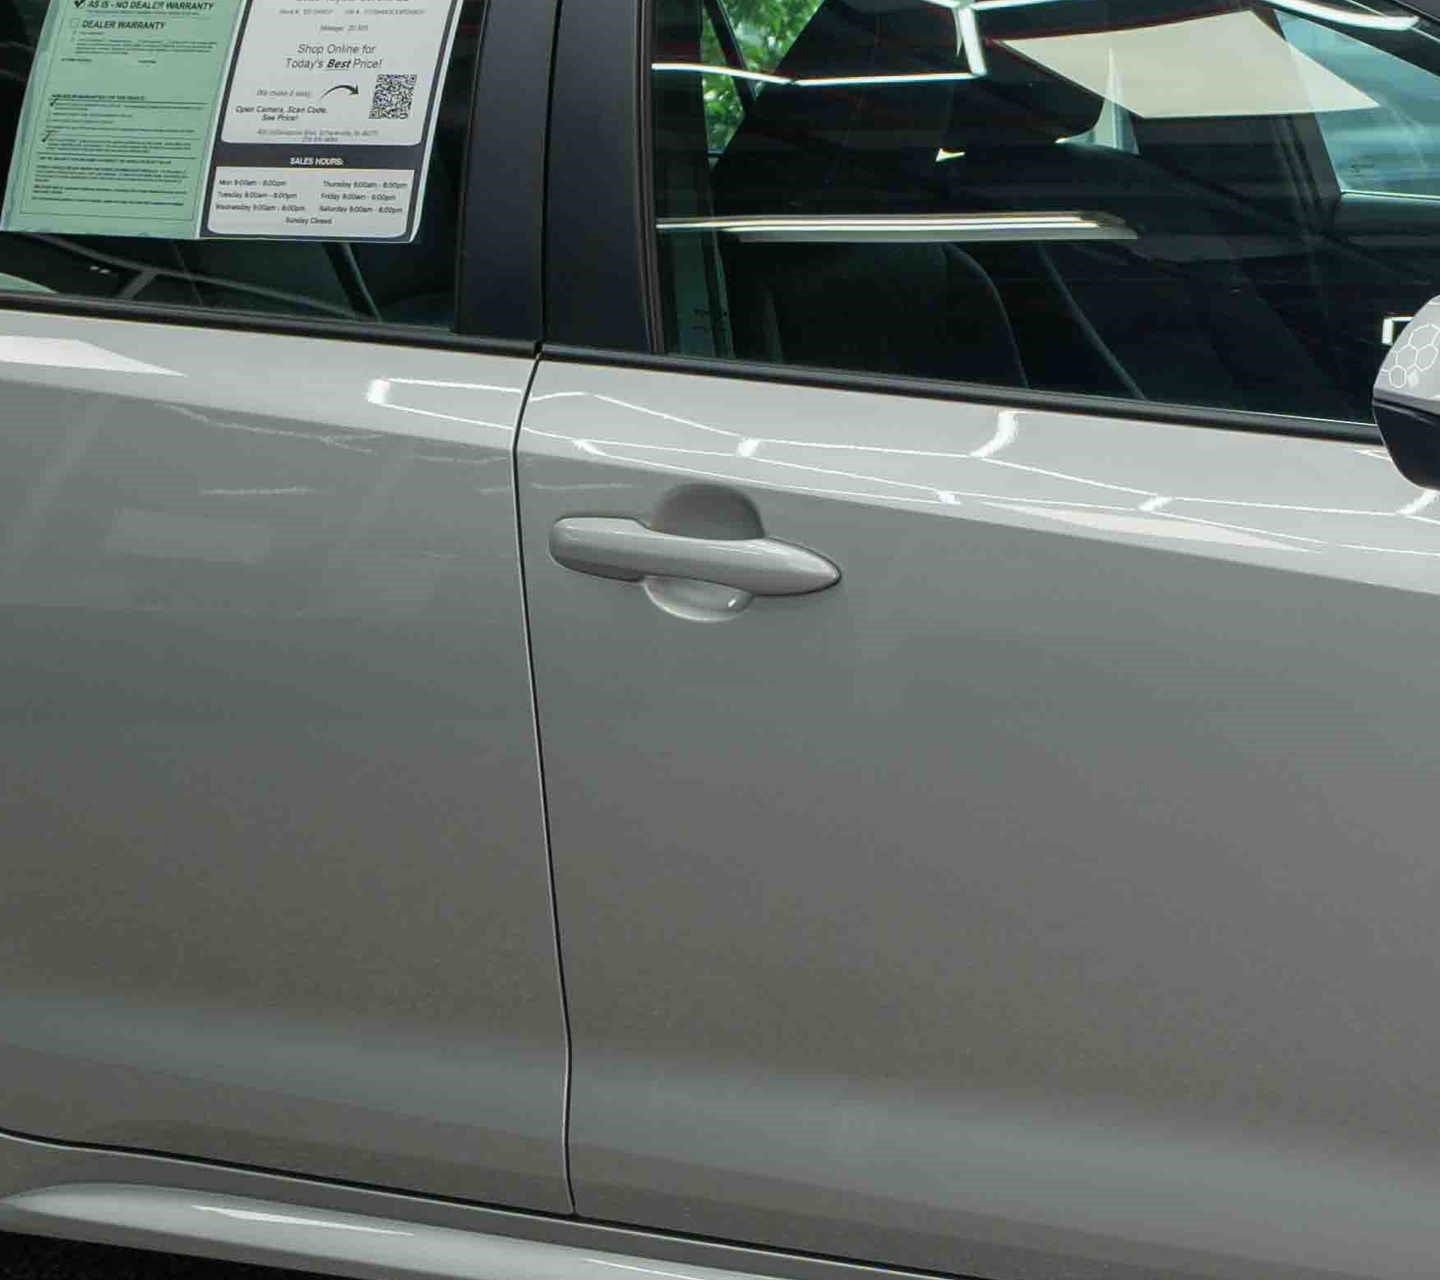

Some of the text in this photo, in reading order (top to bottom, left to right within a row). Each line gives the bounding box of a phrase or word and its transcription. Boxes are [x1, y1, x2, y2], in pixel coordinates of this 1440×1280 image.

[87, 0, 99, 9] AS
[100, 1, 109, 9] IS
[115, 1, 129, 9] NO
[129, 1, 165, 10] DEALER
[165, 2, 215, 11] WARRANTY
[82, 20, 167, 30] DEALER WARRANTY
[297, 44, 376, 56] Shop Online for
[286, 58, 383, 70] Today's Best Price!
[289, 157, 314, 166] SALES
